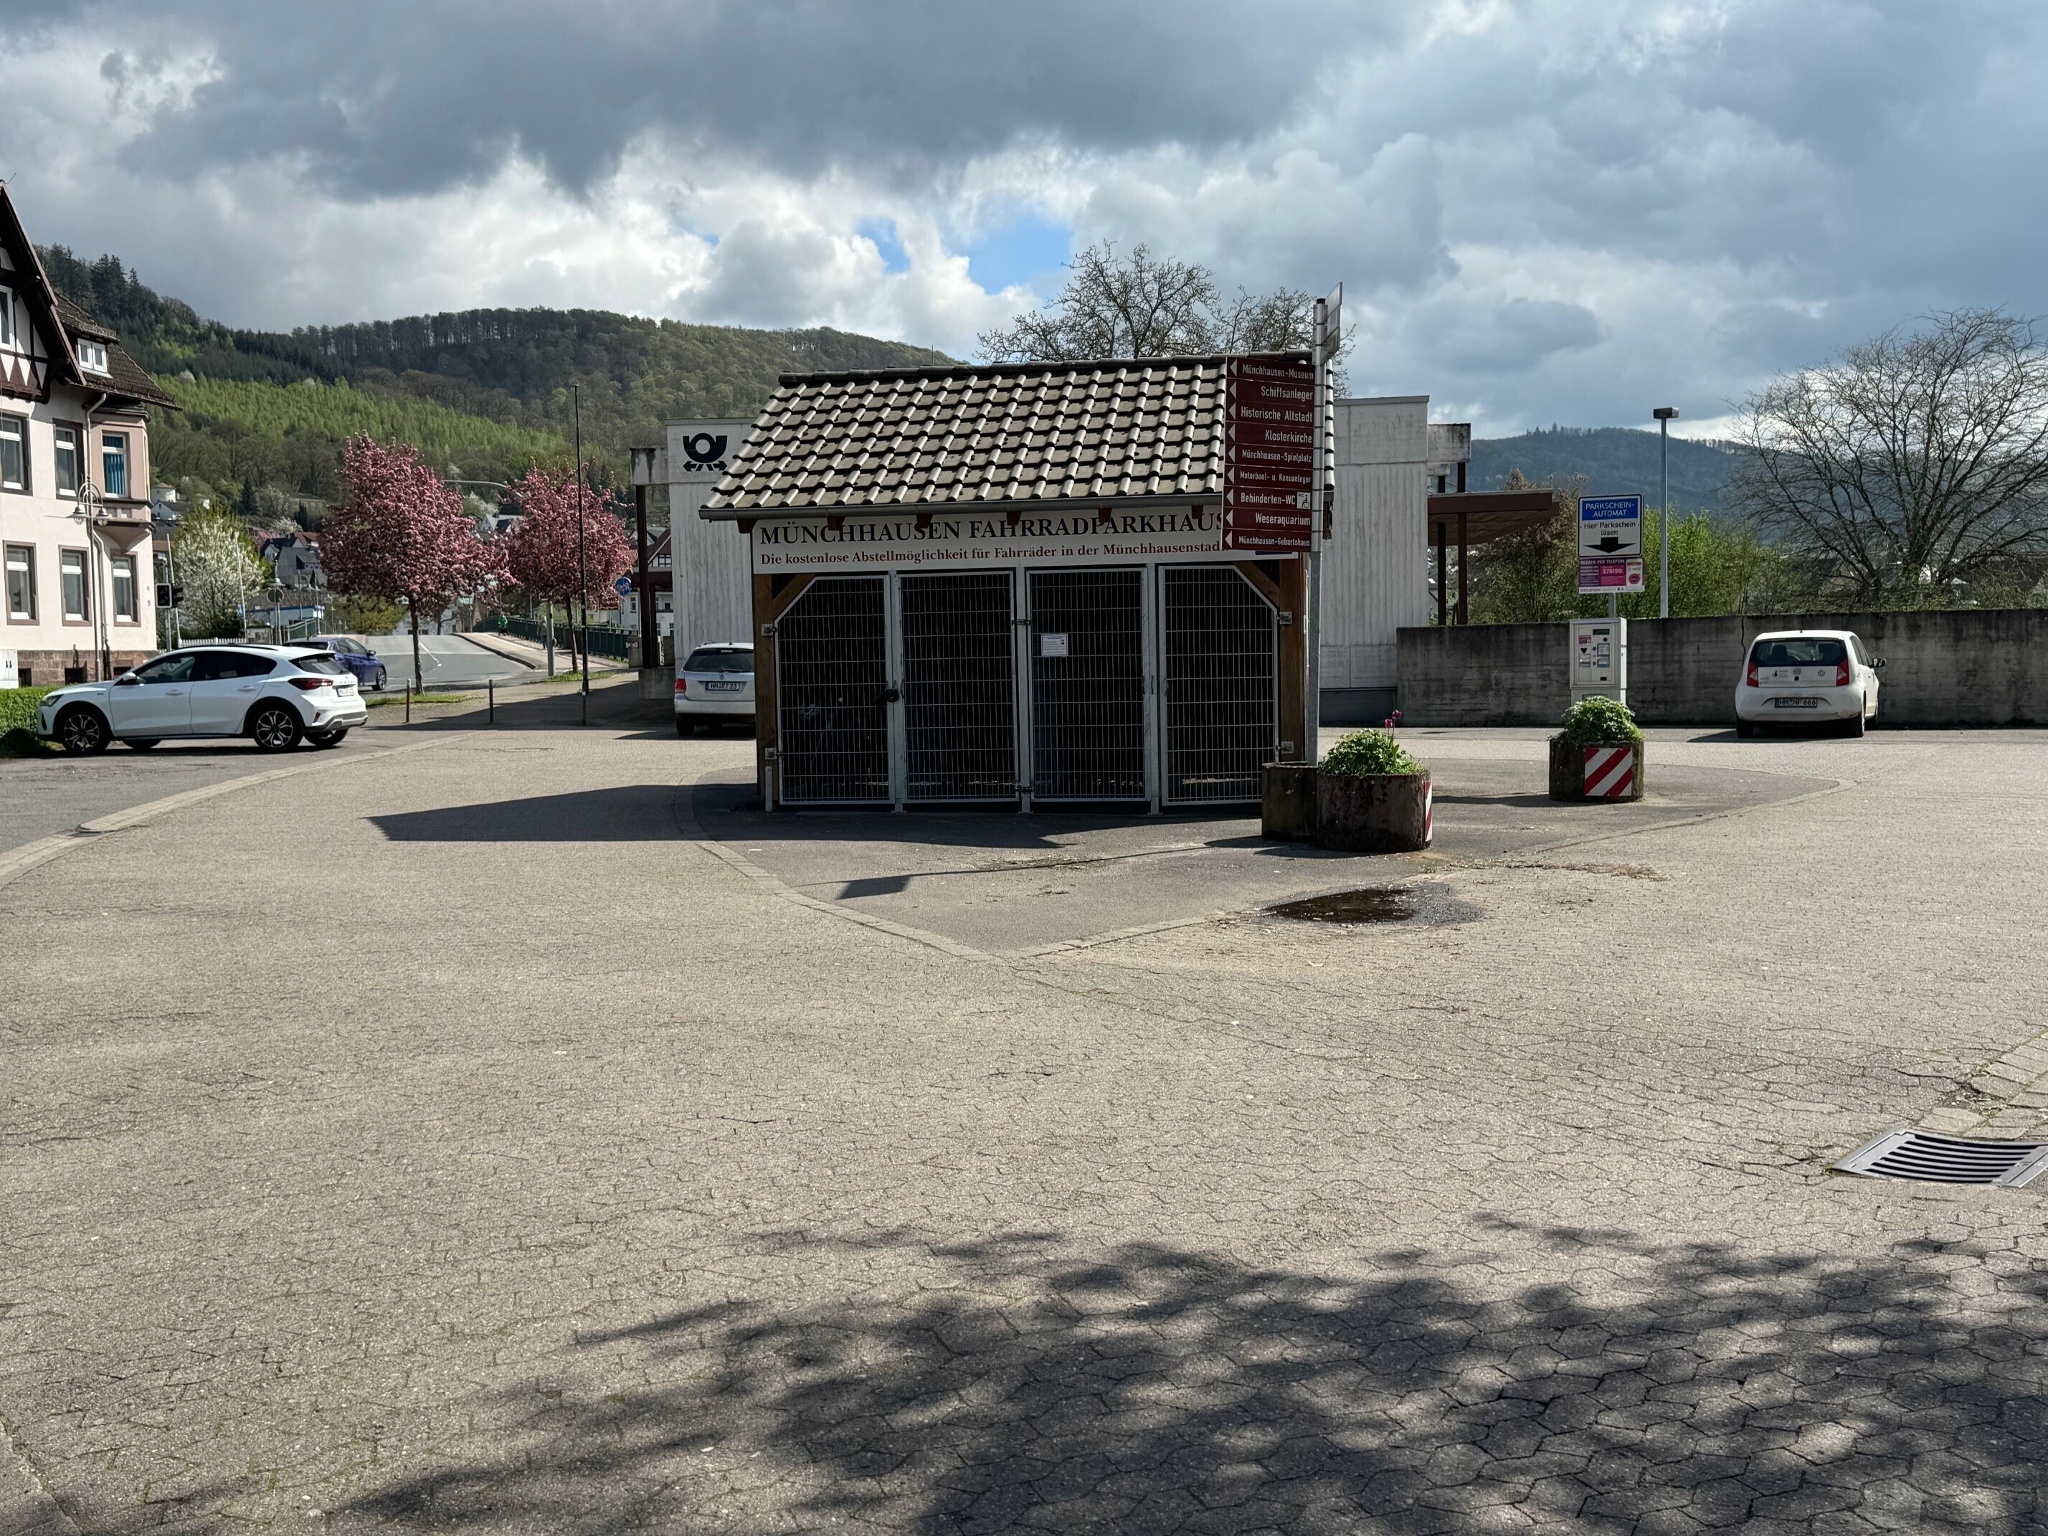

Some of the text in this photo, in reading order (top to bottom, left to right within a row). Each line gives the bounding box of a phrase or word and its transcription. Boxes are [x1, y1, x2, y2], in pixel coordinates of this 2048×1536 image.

[1242, 363, 1314, 380] Münchhausen-Museum
[1260, 385, 1314, 403] Schiffsanleger
[1240, 406, 1313, 423] Historische Altstadt
[1264, 429, 1313, 443] Klosterkirche
[1241, 449, 1312, 463] Münchhausen-Spielplatz
[1240, 492, 1296, 505] Behinderten-WC
[1585, 501, 1635, 510] PARKSCHEIN-
[1255, 512, 1311, 526] Weseraquarium
[1592, 509, 1627, 518] AUTOMAT
[1599, 521, 1636, 529] Parkschein
[760, 521, 961, 544] MÜNCHHAUSEN
[760, 541, 1222, 565] Die kostenlose Abstellmöglichkeit für Fahrräder in der Münchhausenstad
